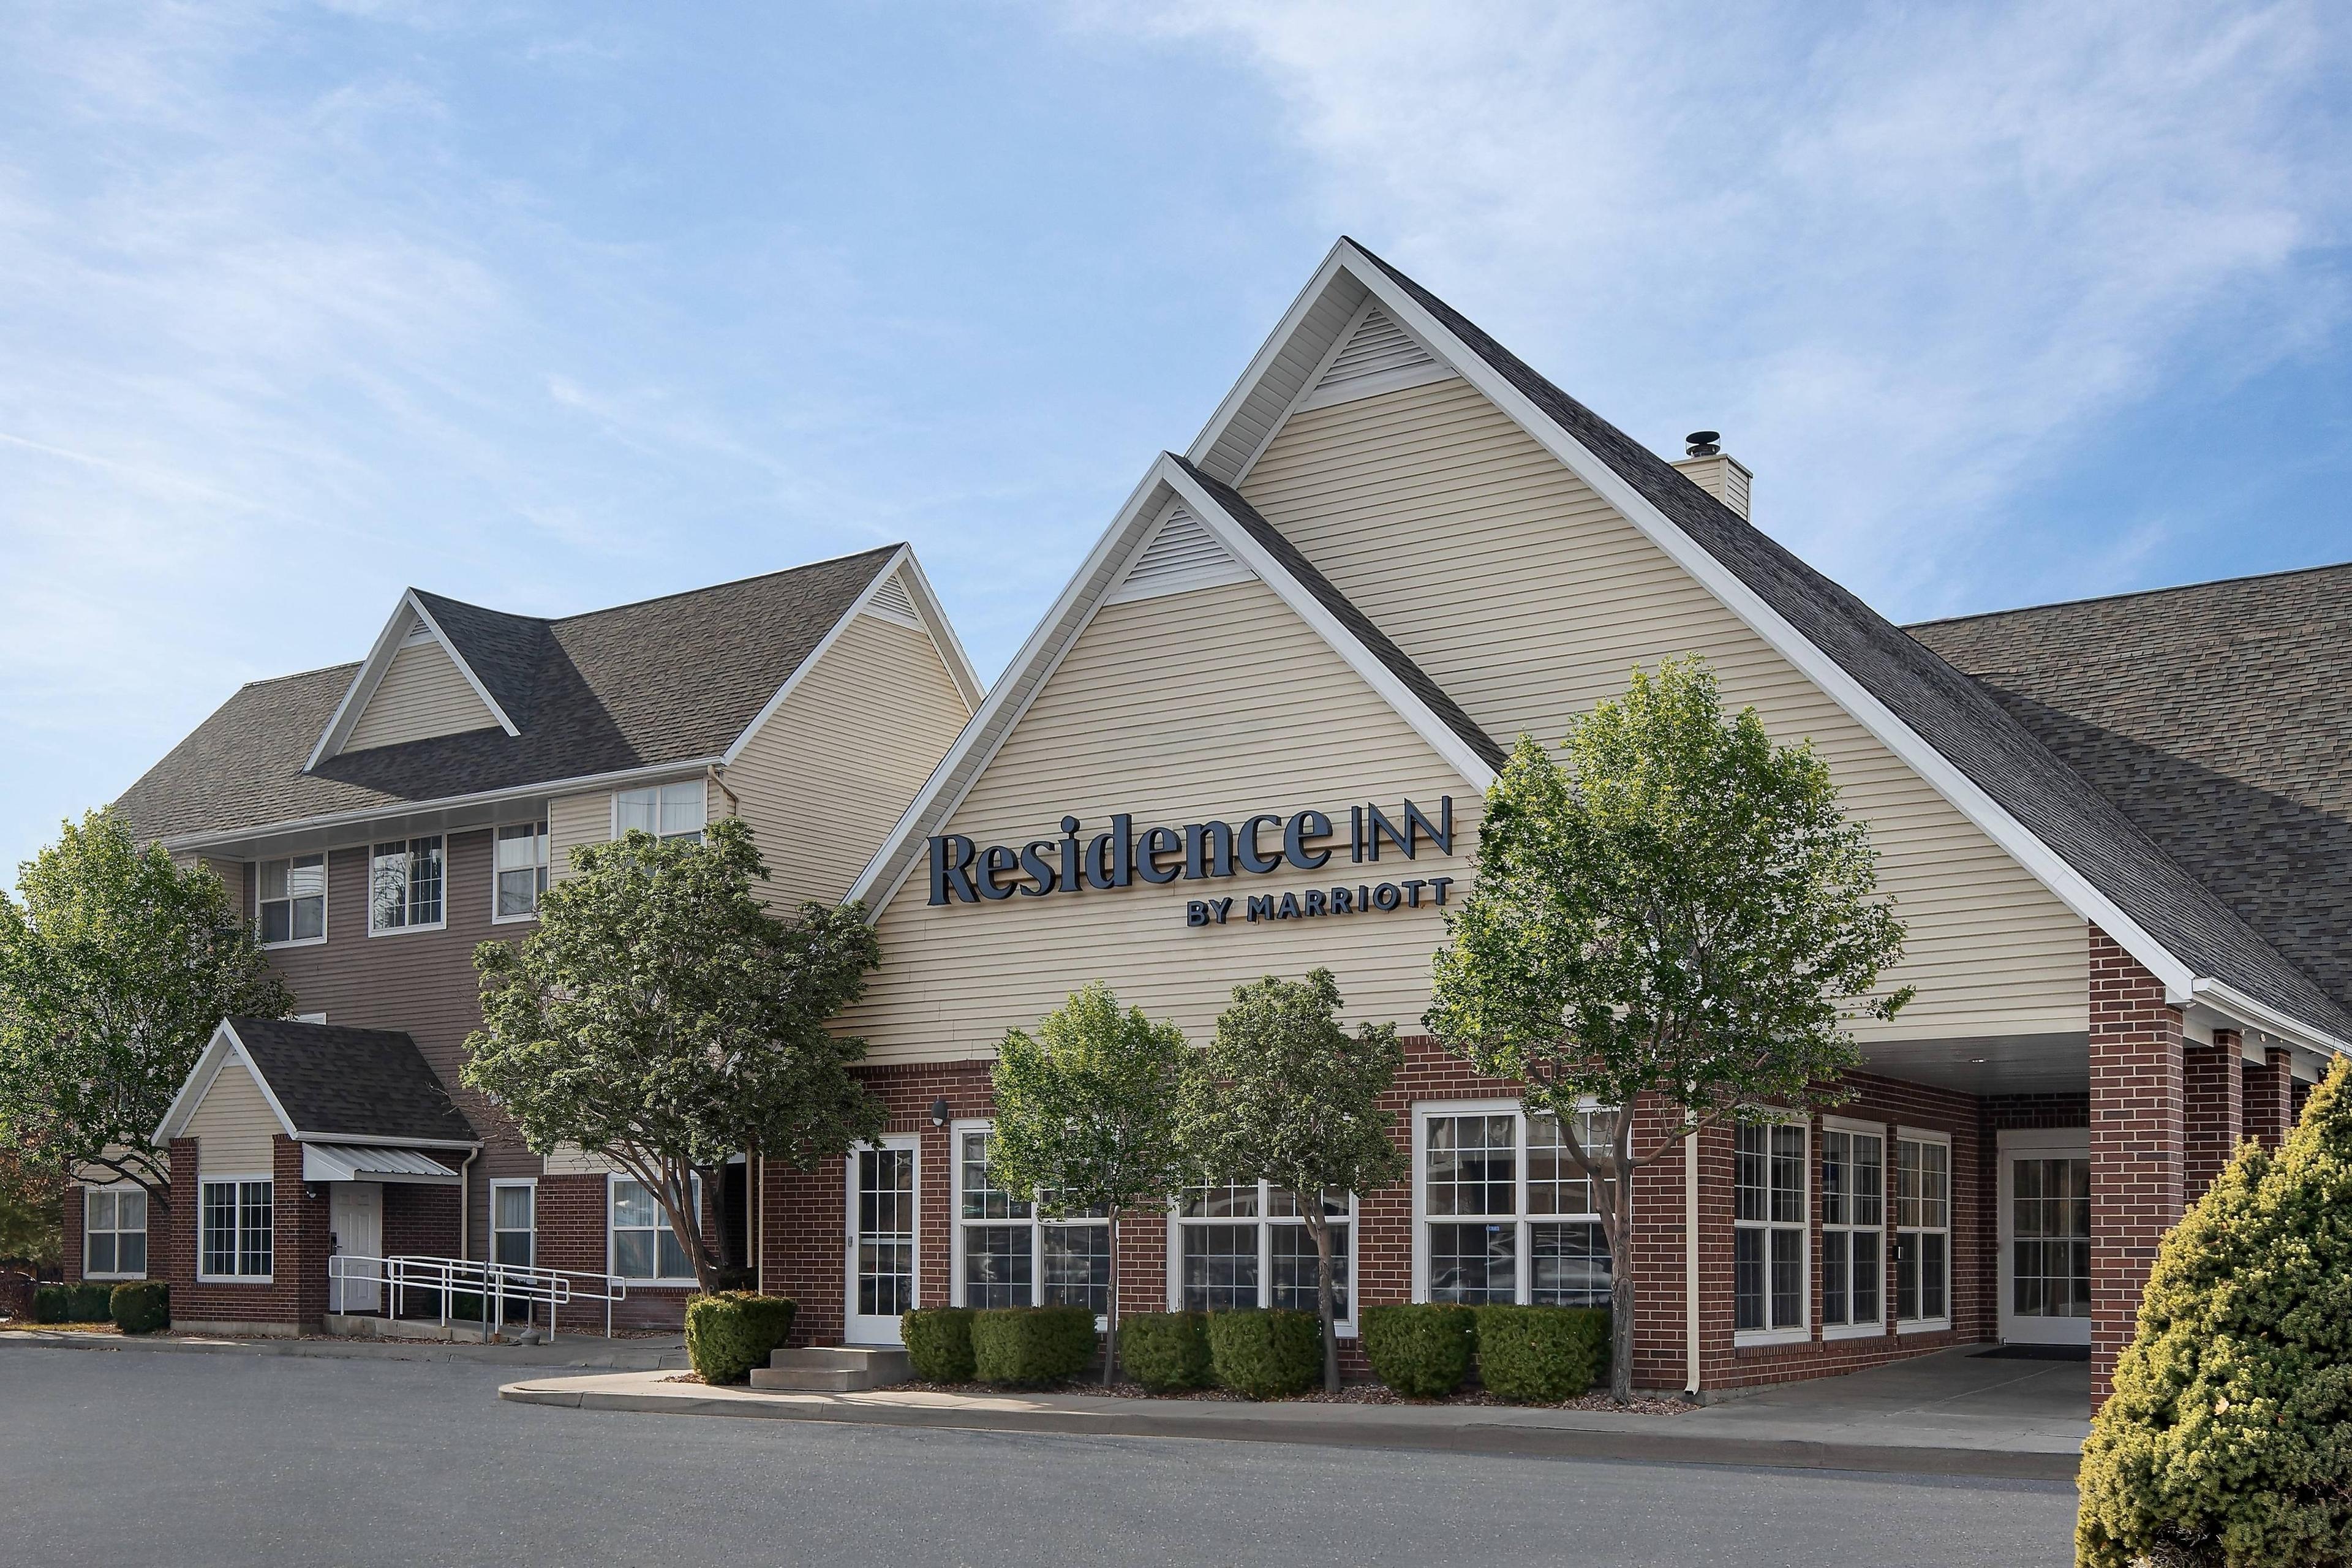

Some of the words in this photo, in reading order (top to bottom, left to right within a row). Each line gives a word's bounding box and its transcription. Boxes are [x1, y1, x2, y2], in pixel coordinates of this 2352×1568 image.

[927, 810, 1332, 906] Residence
[1351, 796, 1453, 863] INN
[1186, 897, 1233, 927] BY
[1246, 877, 1454, 923] MARRIOTT
